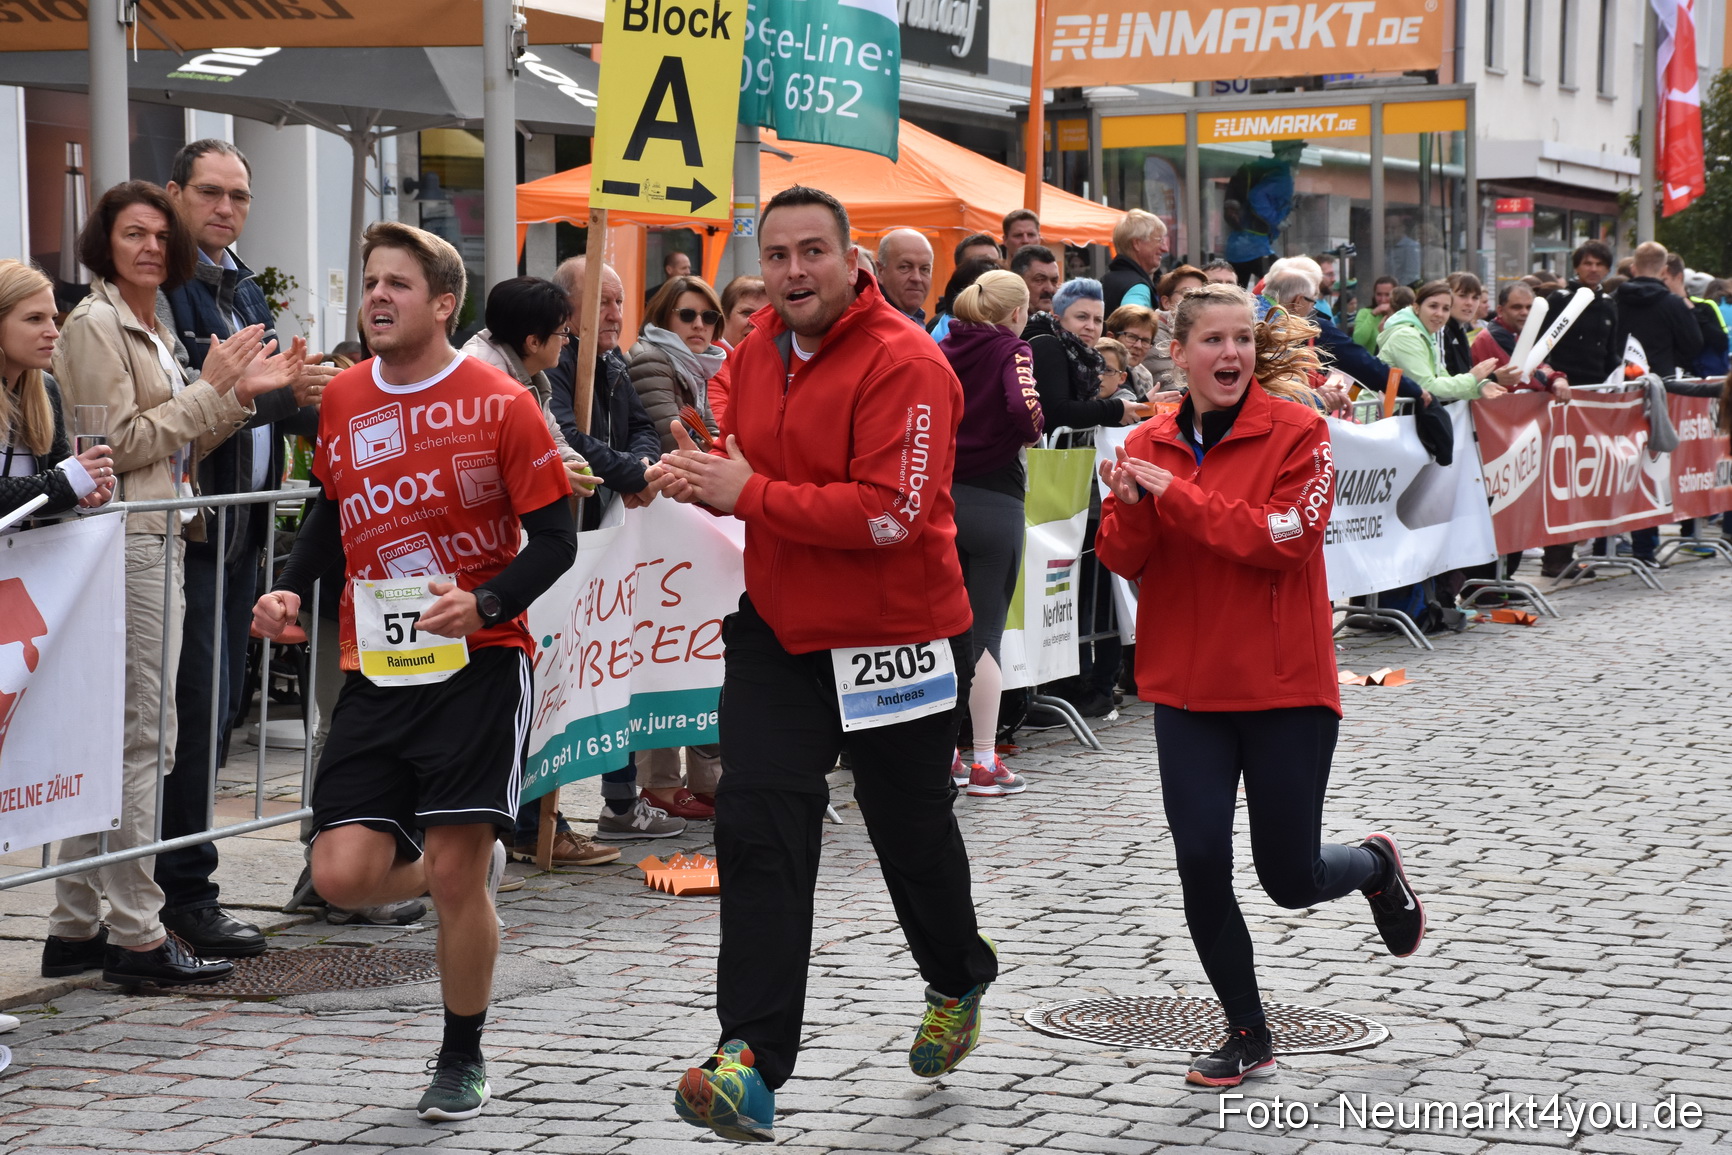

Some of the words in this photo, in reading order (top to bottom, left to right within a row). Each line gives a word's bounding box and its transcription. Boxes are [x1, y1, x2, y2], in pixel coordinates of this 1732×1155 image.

[622, 0, 733, 40] Block
[1050, 1, 1423, 61] RUNMARKT.DE
[785, 72, 863, 118] 6352
[622, 55, 704, 167] A
[1214, 113, 1357, 137] RUNMARKT.DE
[352, 408, 398, 431] raumbox
[414, 431, 476, 452] schenken
[898, 404, 931, 523] raumbox
[354, 520, 393, 544] wohnen
[400, 505, 449, 526] outdoor
[381, 538, 428, 561] raumbox
[385, 587, 422, 599] BOCK
[387, 653, 435, 667] Raimund
[851, 641, 936, 686] 2505
[877, 688, 925, 706] Andreas
[540, 759, 549, 777] 0
[46, 773, 83, 803] ZÄHLT
